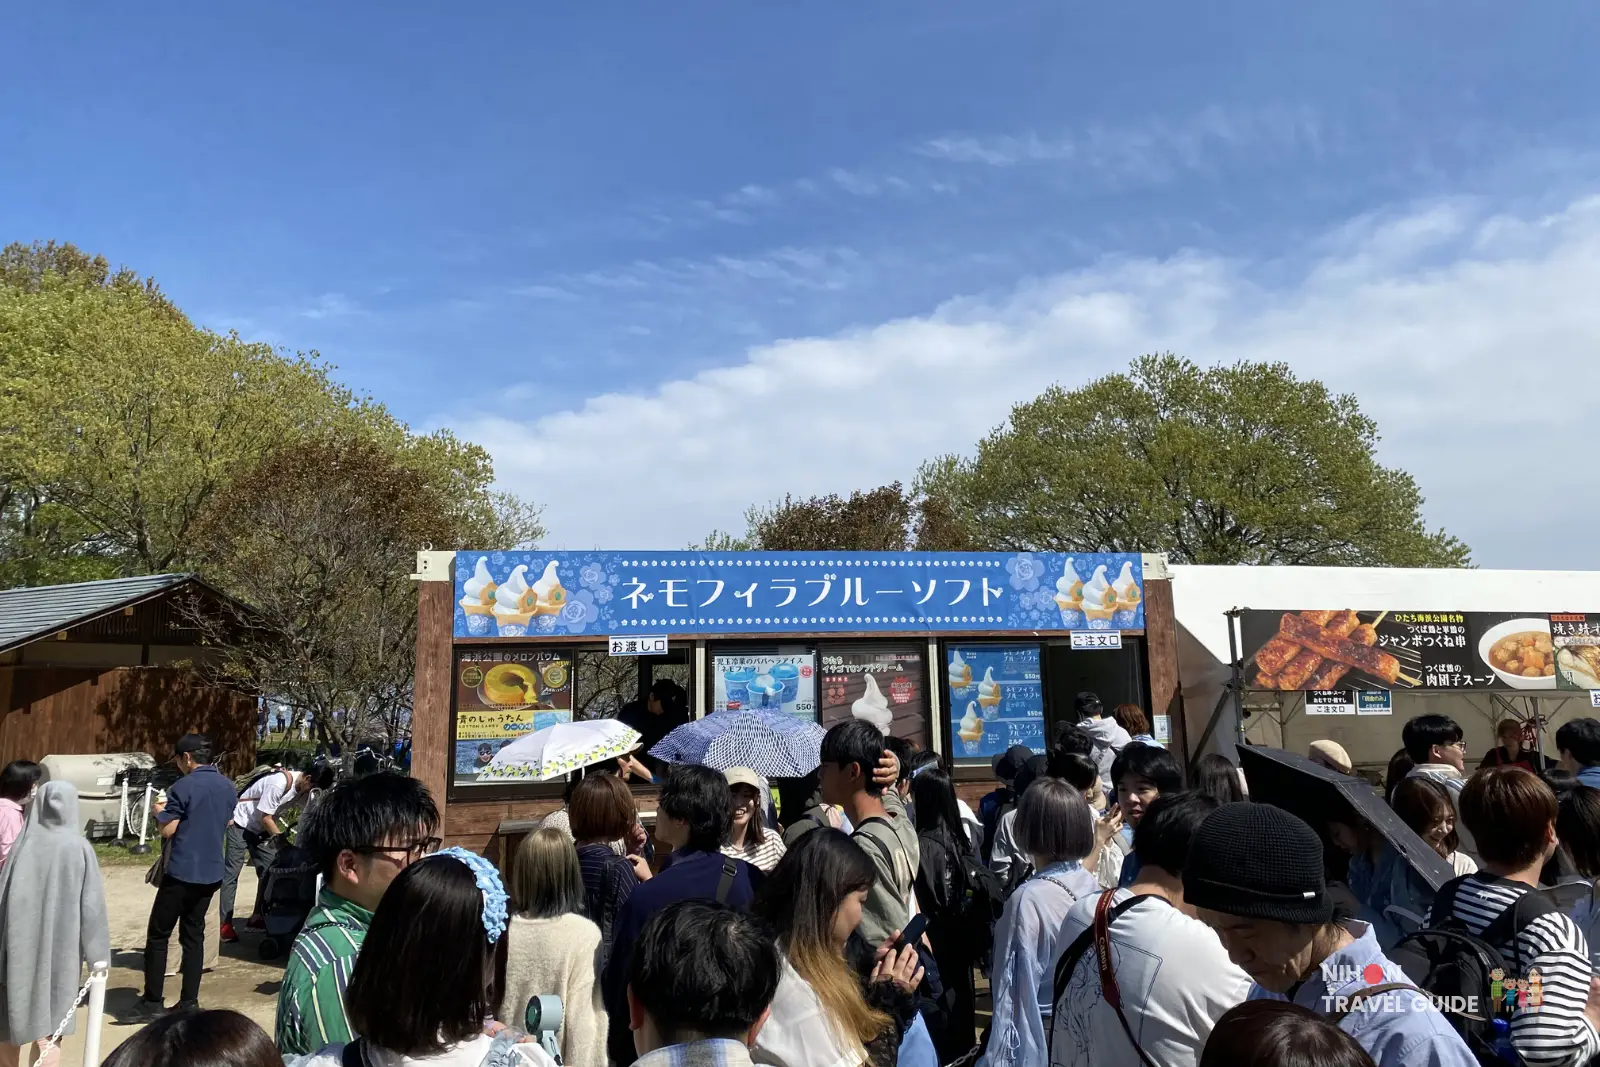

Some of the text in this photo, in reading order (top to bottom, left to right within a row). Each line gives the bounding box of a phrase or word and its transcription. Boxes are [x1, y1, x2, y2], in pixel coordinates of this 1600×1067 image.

[620, 575, 1004, 609] ネモフィラブルーソフト
[1394, 614, 1464, 623] ひたち海浜公園名物
[612, 640, 665, 652] お渡し口
[1073, 635, 1119, 646] ご注文口
[1379, 635, 1466, 648] ジャンボつくね串
[1425, 664, 1462, 673] つくば鶏の
[1426, 673, 1496, 687] 肉団子スープ
[1316, 705, 1345, 713] ご注文口
[1098, 936, 1108, 971] Canon
